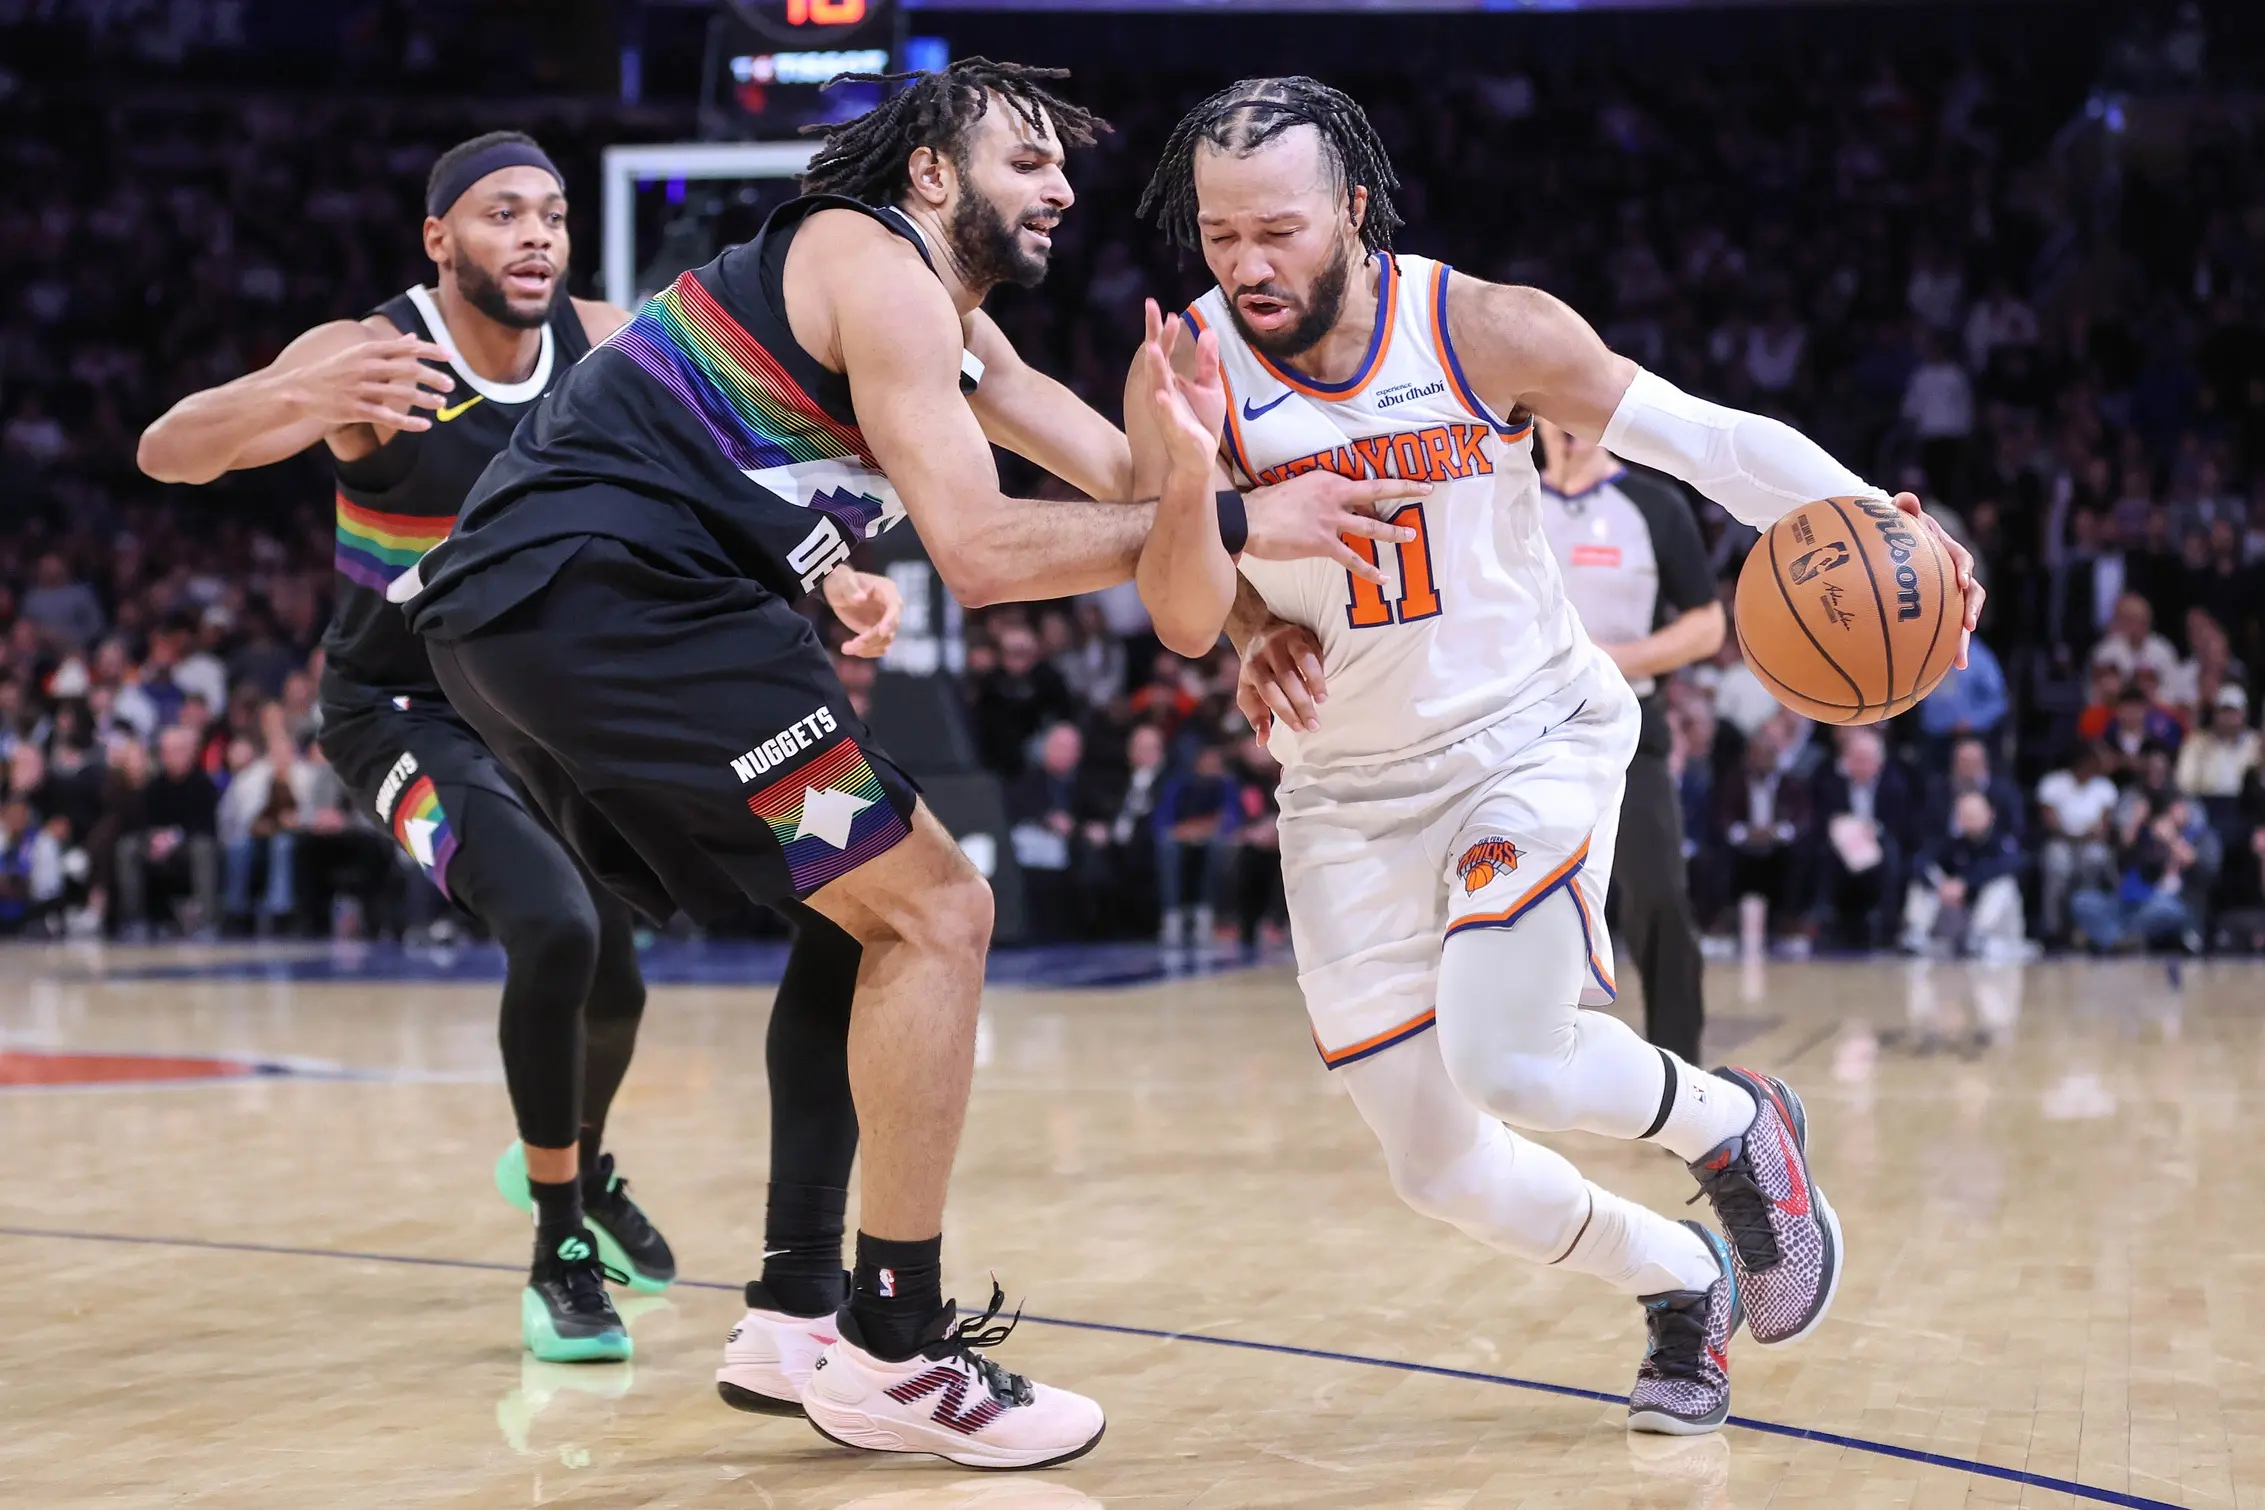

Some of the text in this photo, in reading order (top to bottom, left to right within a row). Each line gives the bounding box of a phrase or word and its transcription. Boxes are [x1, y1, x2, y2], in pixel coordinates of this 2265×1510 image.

[1376, 383, 1412, 396] experience
[1378, 380, 1445, 409] abu dhabi
[1351, 424, 1494, 482] YORK
[1340, 502, 1443, 629] 11
[1853, 499, 1923, 623] Wilson
[729, 706, 838, 784] NUGGETS
[1457, 841, 1518, 872] KNICKS
